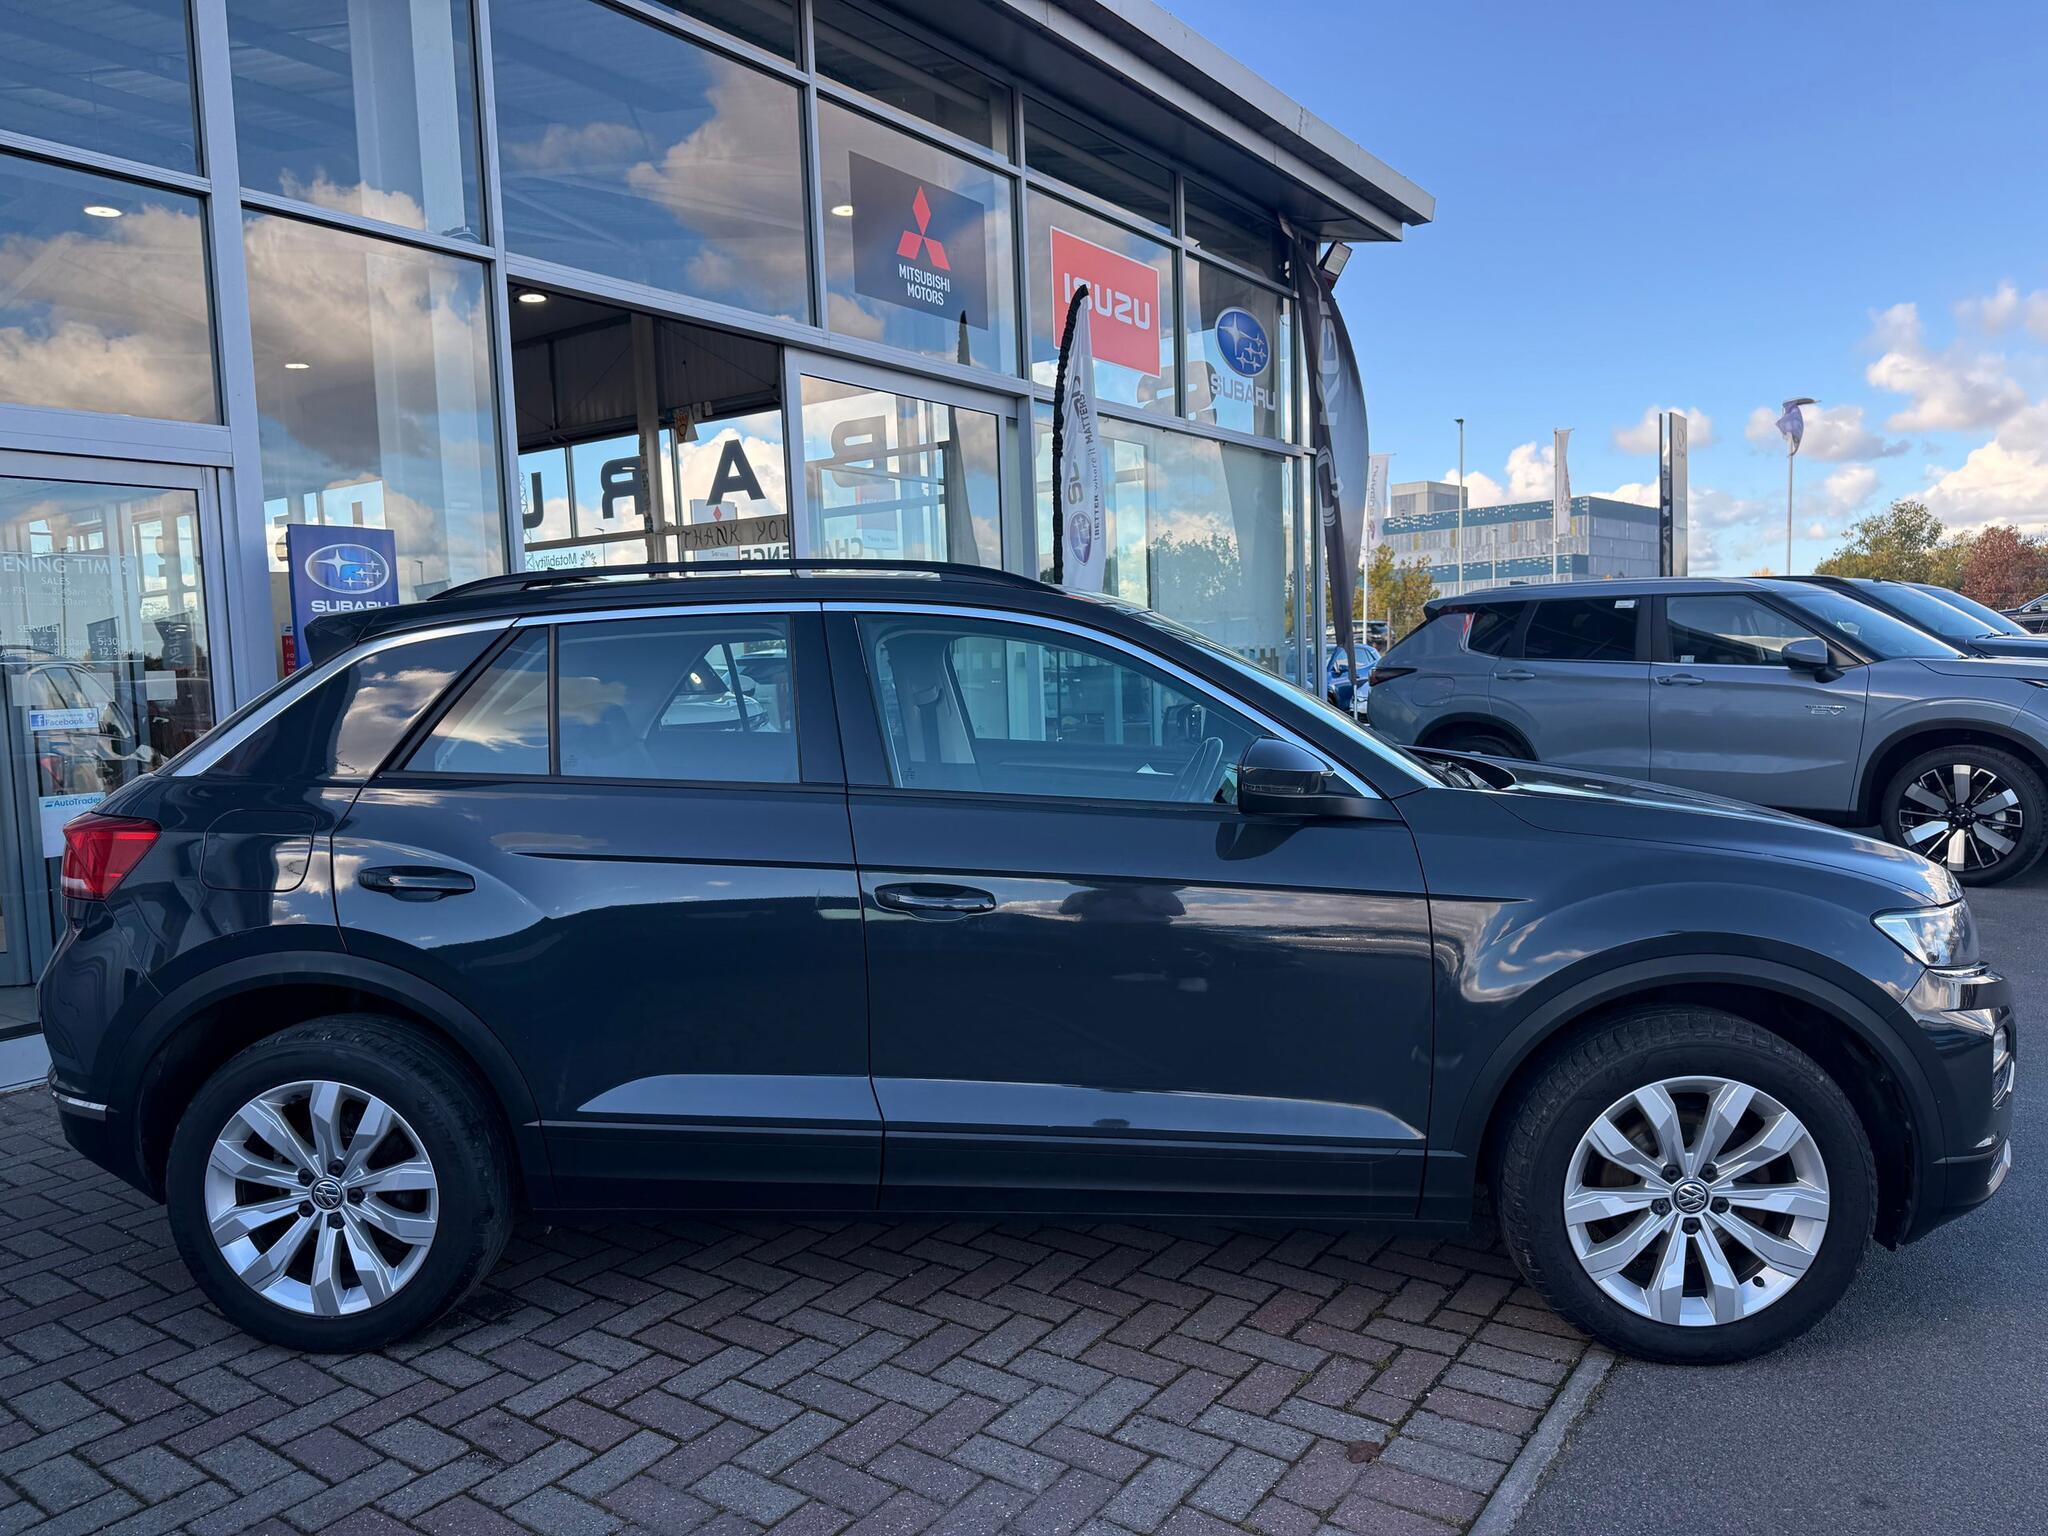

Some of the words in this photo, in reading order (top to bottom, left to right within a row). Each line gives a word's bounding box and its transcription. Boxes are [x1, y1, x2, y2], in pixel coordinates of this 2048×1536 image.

[898, 263, 951, 293] MITSUBISHI
[907, 281, 945, 306] MOTORS
[1210, 373, 1276, 412] SUBARU
[1079, 393, 1094, 444] MATTERS
[682, 523, 740, 549] THANK
[73, 558, 130, 576] TIMS
[16, 624, 58, 633] SERVICE
[46, 717, 84, 727] Facebook
